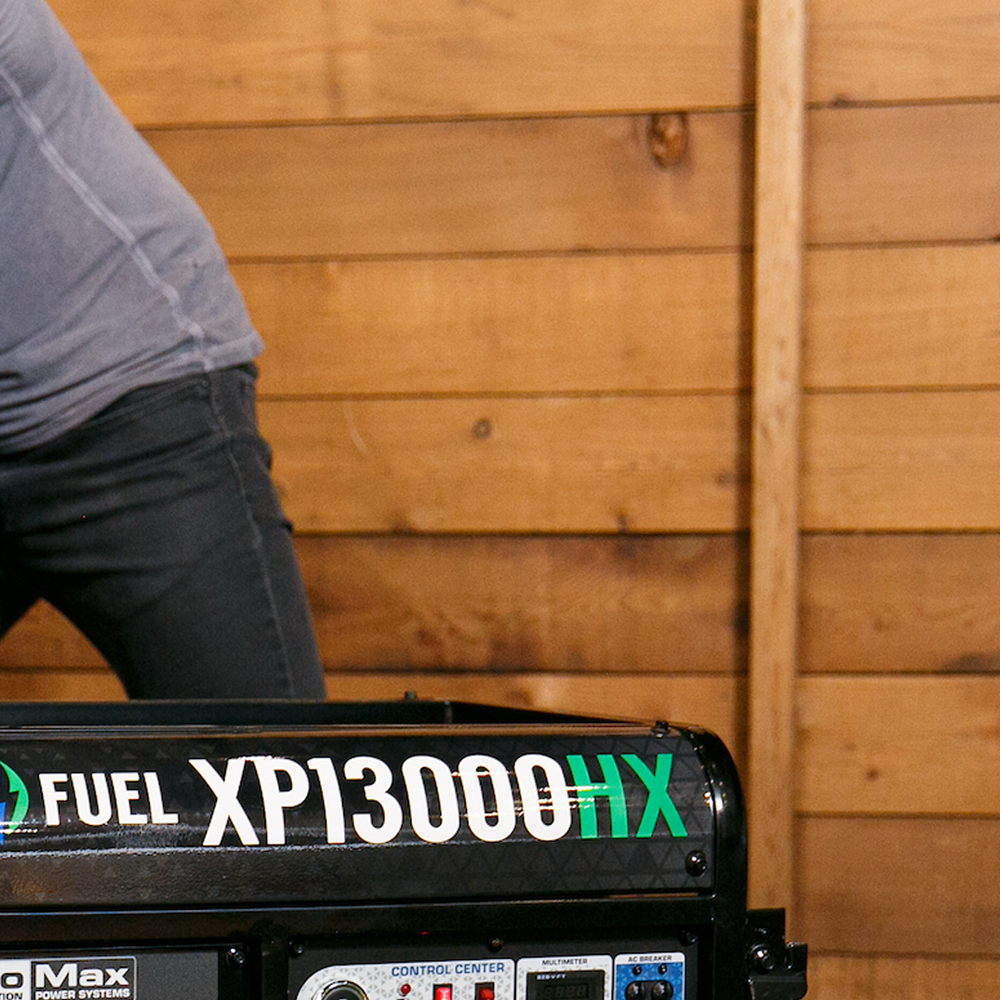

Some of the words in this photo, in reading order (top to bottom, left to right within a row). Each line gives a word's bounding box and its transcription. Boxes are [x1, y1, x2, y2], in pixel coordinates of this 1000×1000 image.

[39, 771, 179, 826] FUEL
[188, 753, 688, 846] XP13000HX
[541, 958, 588, 966] MULTIMETER
[391, 965, 451, 977] CONTROL
[454, 963, 505, 974] CENTER
[35, 990, 76, 1000] POWER
[78, 988, 131, 999] SYSTEMS
